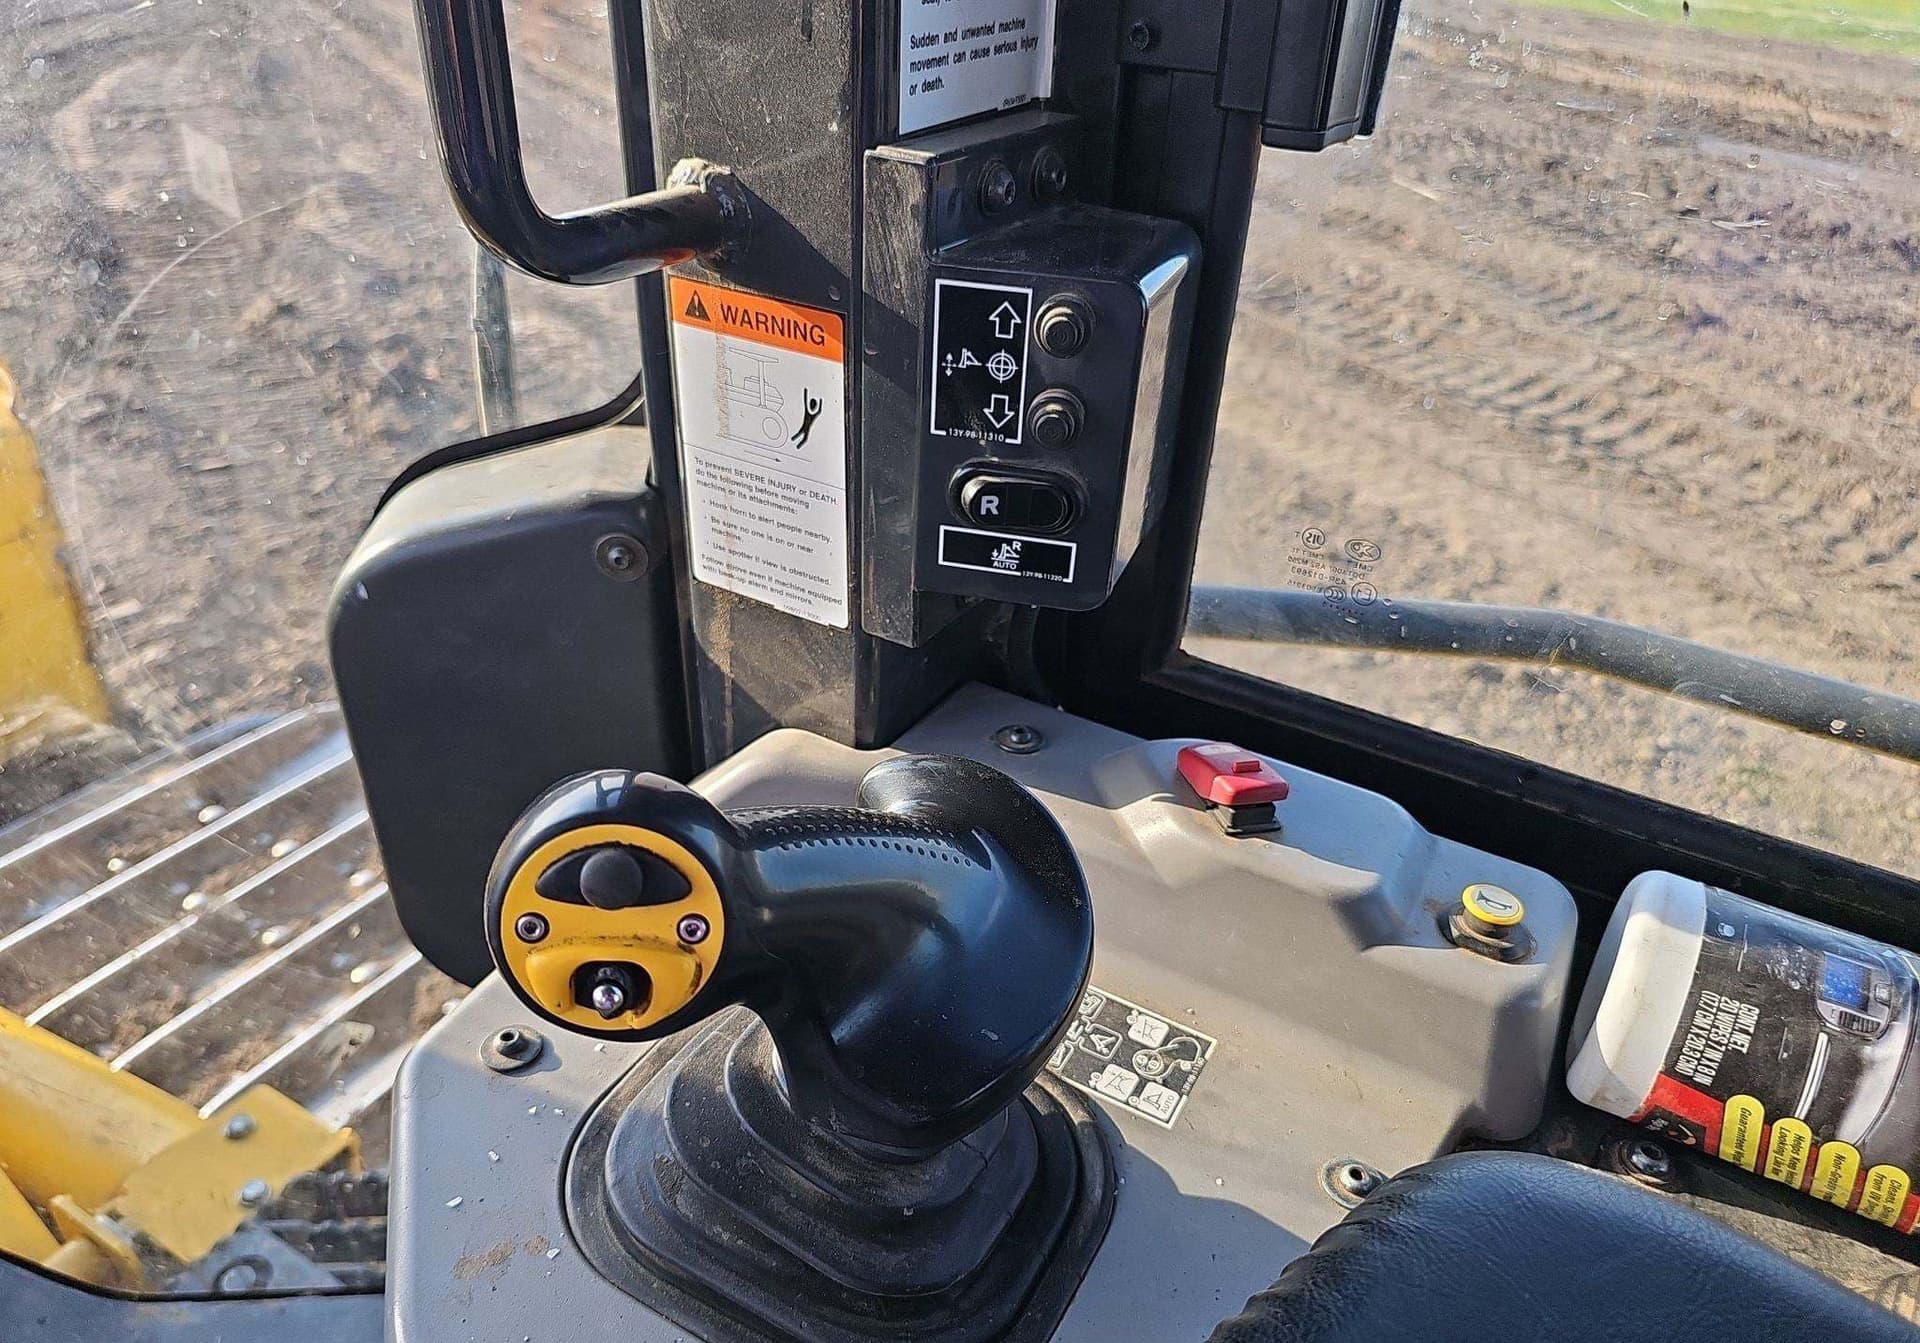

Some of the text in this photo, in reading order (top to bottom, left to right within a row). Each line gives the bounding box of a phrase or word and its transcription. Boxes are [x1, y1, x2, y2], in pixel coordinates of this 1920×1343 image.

[910, 18, 1026, 50] Sudden and unwanted machine
[910, 36, 1039, 73] movement can cause serious injury
[910, 76, 944, 96] or death.
[720, 303, 825, 346] WARNING
[695, 457, 703, 466] To
[705, 461, 732, 475] prevent
[735, 469, 766, 484] SEVERE
[768, 479, 797, 492] INJURY
[697, 480, 726, 493] machine
[738, 489, 746, 499] its
[706, 471, 717, 480] the
[720, 476, 753, 491] following
[755, 485, 779, 499] before
[781, 495, 810, 509] moving
[981, 496, 999, 516] R
[710, 501, 833, 544] Honk horn to alert people nearby.
[711, 515, 720, 525] Be
[723, 521, 737, 530] sure
[740, 526, 749, 534] no
[751, 530, 765, 539] one
[767, 533, 773, 542] is
[775, 537, 785, 545] on
[713, 543, 726, 552] Use
[728, 547, 753, 561] spotter
[762, 558, 778, 569] view
[780, 562, 787, 572] is
[1012, 541, 1022, 551] R
[993, 560, 1017, 570] AUTO
[702, 554, 724, 566] Follow
[749, 570, 766, 581] even
[775, 576, 806, 594] machine
[808, 587, 842, 606] equipped
[748, 578, 768, 591] alarm
[770, 586, 783, 596] and
[1698, 990, 1720, 1012] (17.7
[1689, 1026, 1708, 1037] X
[1692, 1010, 1714, 1028] CM
[1727, 1003, 1760, 1054] CONT. NET.
[1692, 996, 1740, 1086] 20 WIPES 7 IN X 8 IN
[1674, 1055, 1698, 1076] CM)
[1161, 1094, 1174, 1114] AUTO
[1735, 1107, 1752, 1151] Guaranteed
[1772, 1126, 1790, 1156] Looking
[1790, 1133, 1805, 1157] Helps
[1787, 1154, 1801, 1172] Keep
[1824, 1152, 1846, 1192] Non-Greasy
[1870, 1171, 1887, 1192] from
